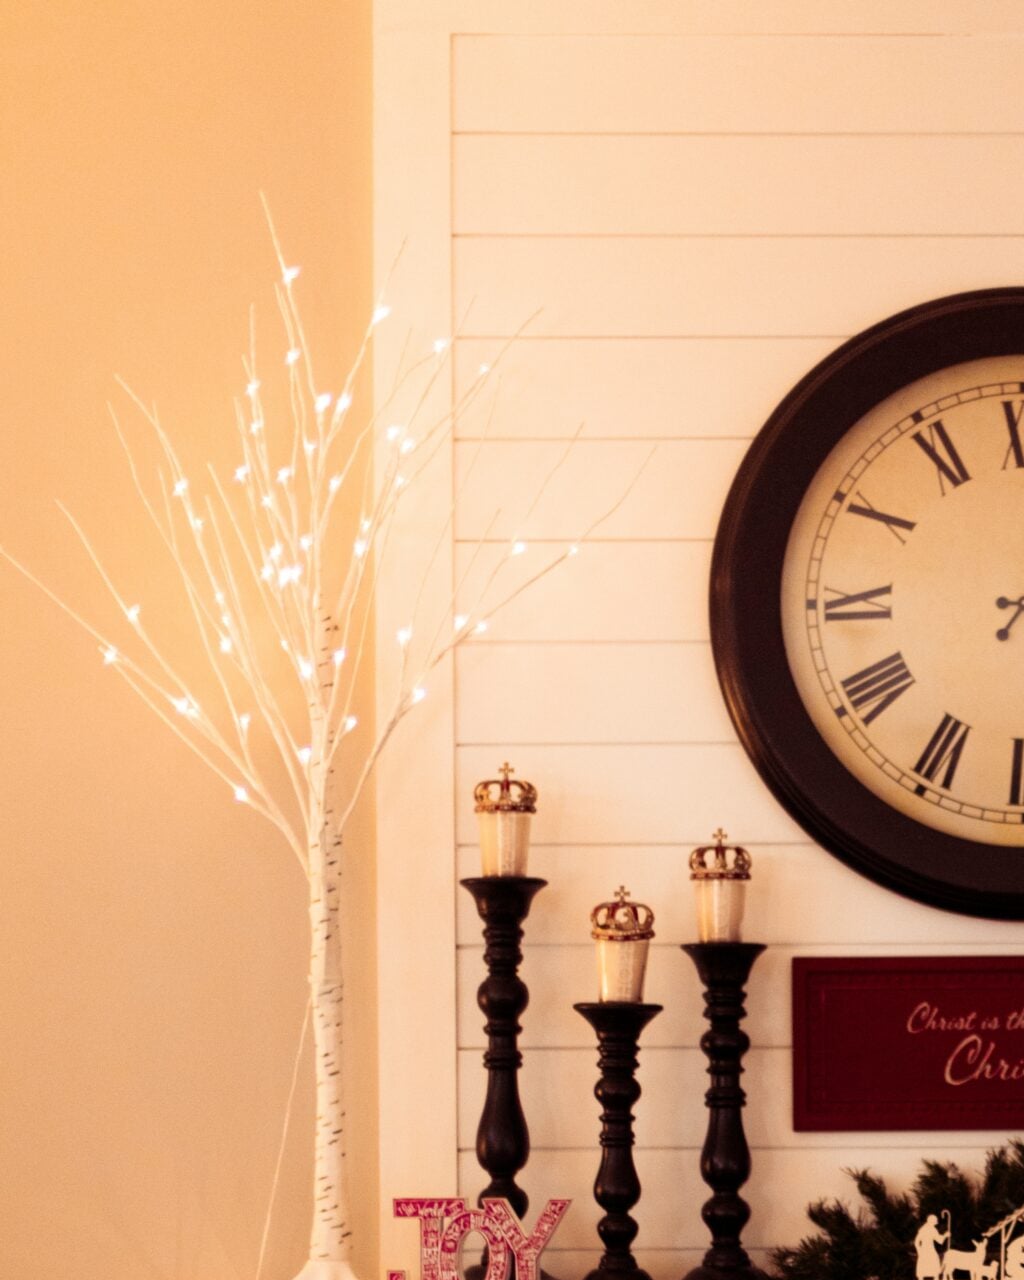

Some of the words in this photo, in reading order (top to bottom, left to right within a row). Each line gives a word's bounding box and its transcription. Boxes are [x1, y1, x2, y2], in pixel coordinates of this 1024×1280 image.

[911, 419, 973, 497] XI
[846, 490, 917, 545] X
[823, 582, 893, 622] IX
[840, 650, 917, 728] VIII
[911, 712, 972, 791] VII
[906, 1001, 976, 1034] Christ
[980, 1014, 1001, 1031] is
